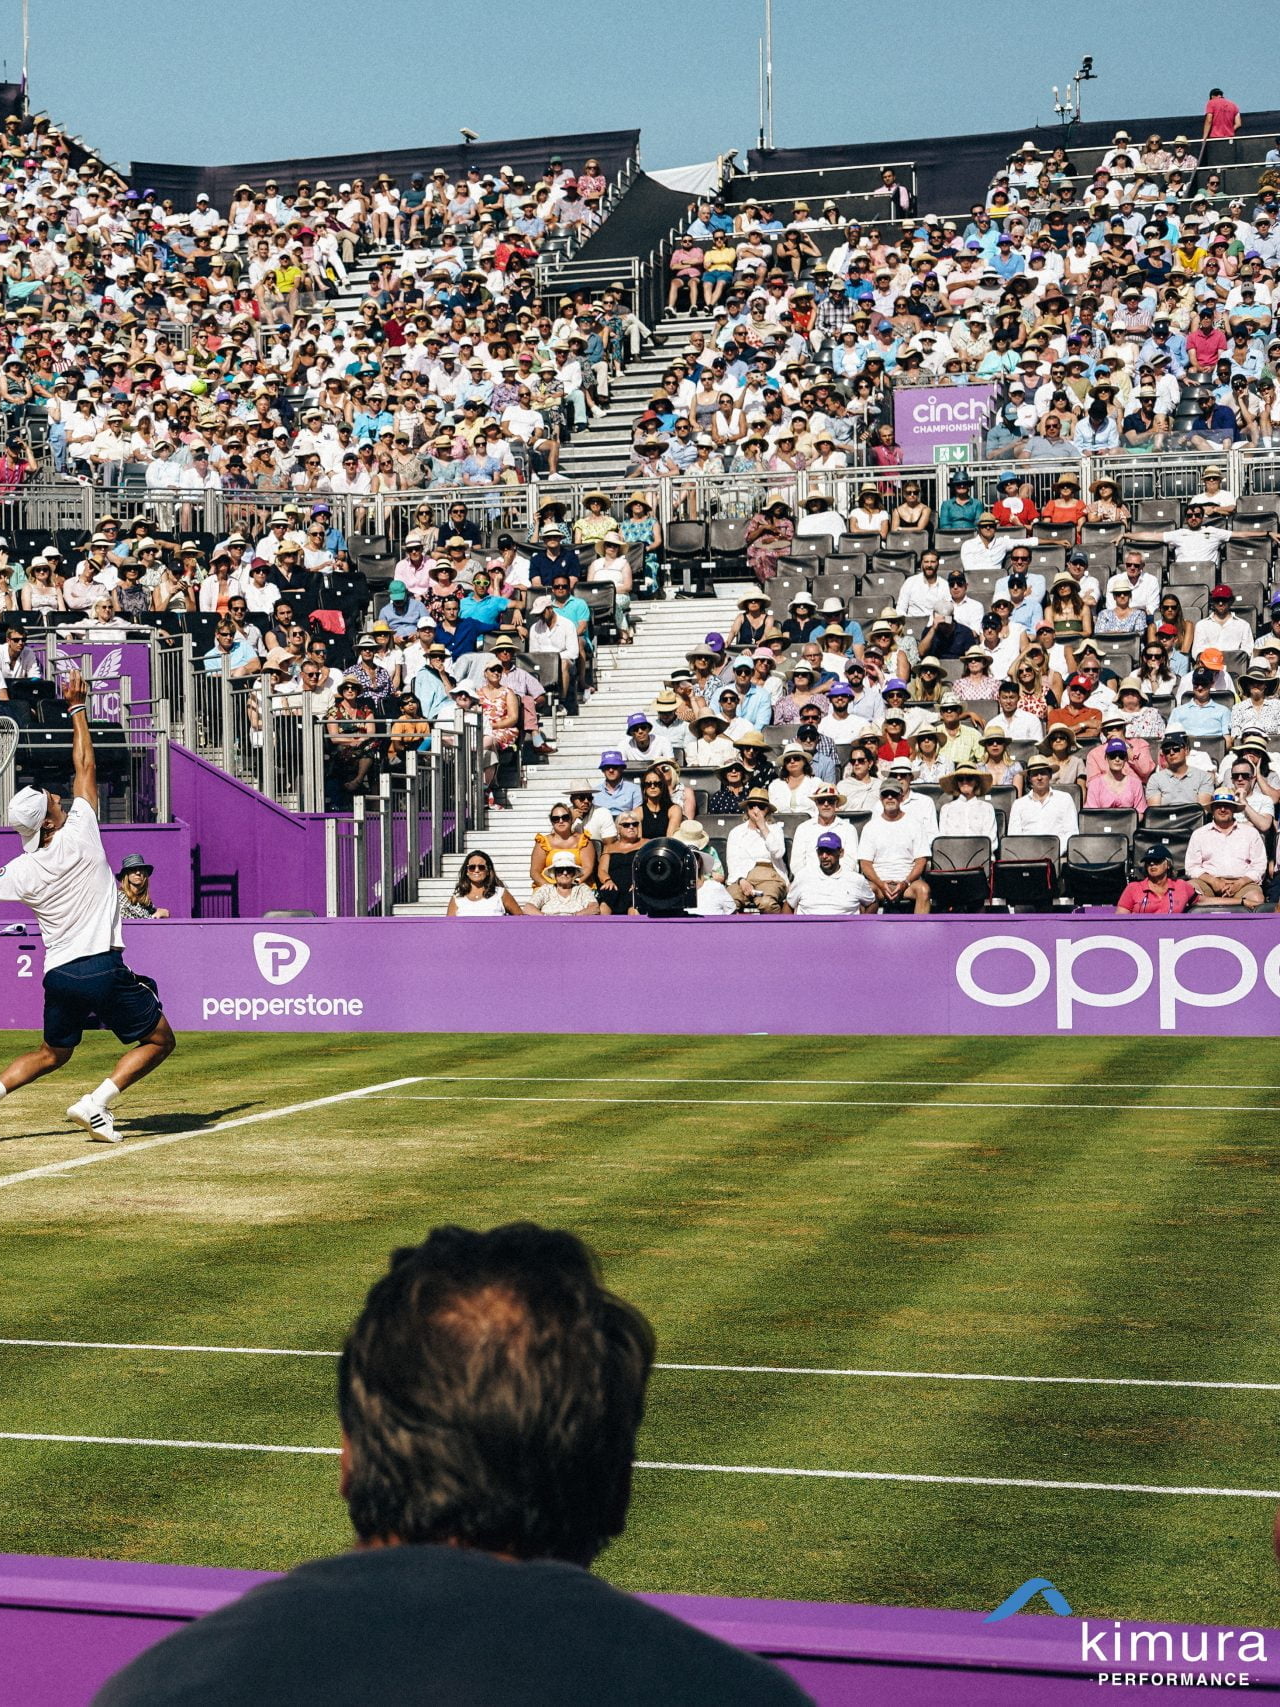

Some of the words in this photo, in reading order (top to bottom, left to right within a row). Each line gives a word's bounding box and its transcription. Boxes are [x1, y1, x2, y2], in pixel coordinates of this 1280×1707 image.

[912, 395, 988, 423] cinch
[913, 422, 986, 434] CHAMPIONSHI
[16, 954, 33, 978] 2
[955, 934, 1280, 1030] opp
[202, 993, 364, 1021] pepperstone
